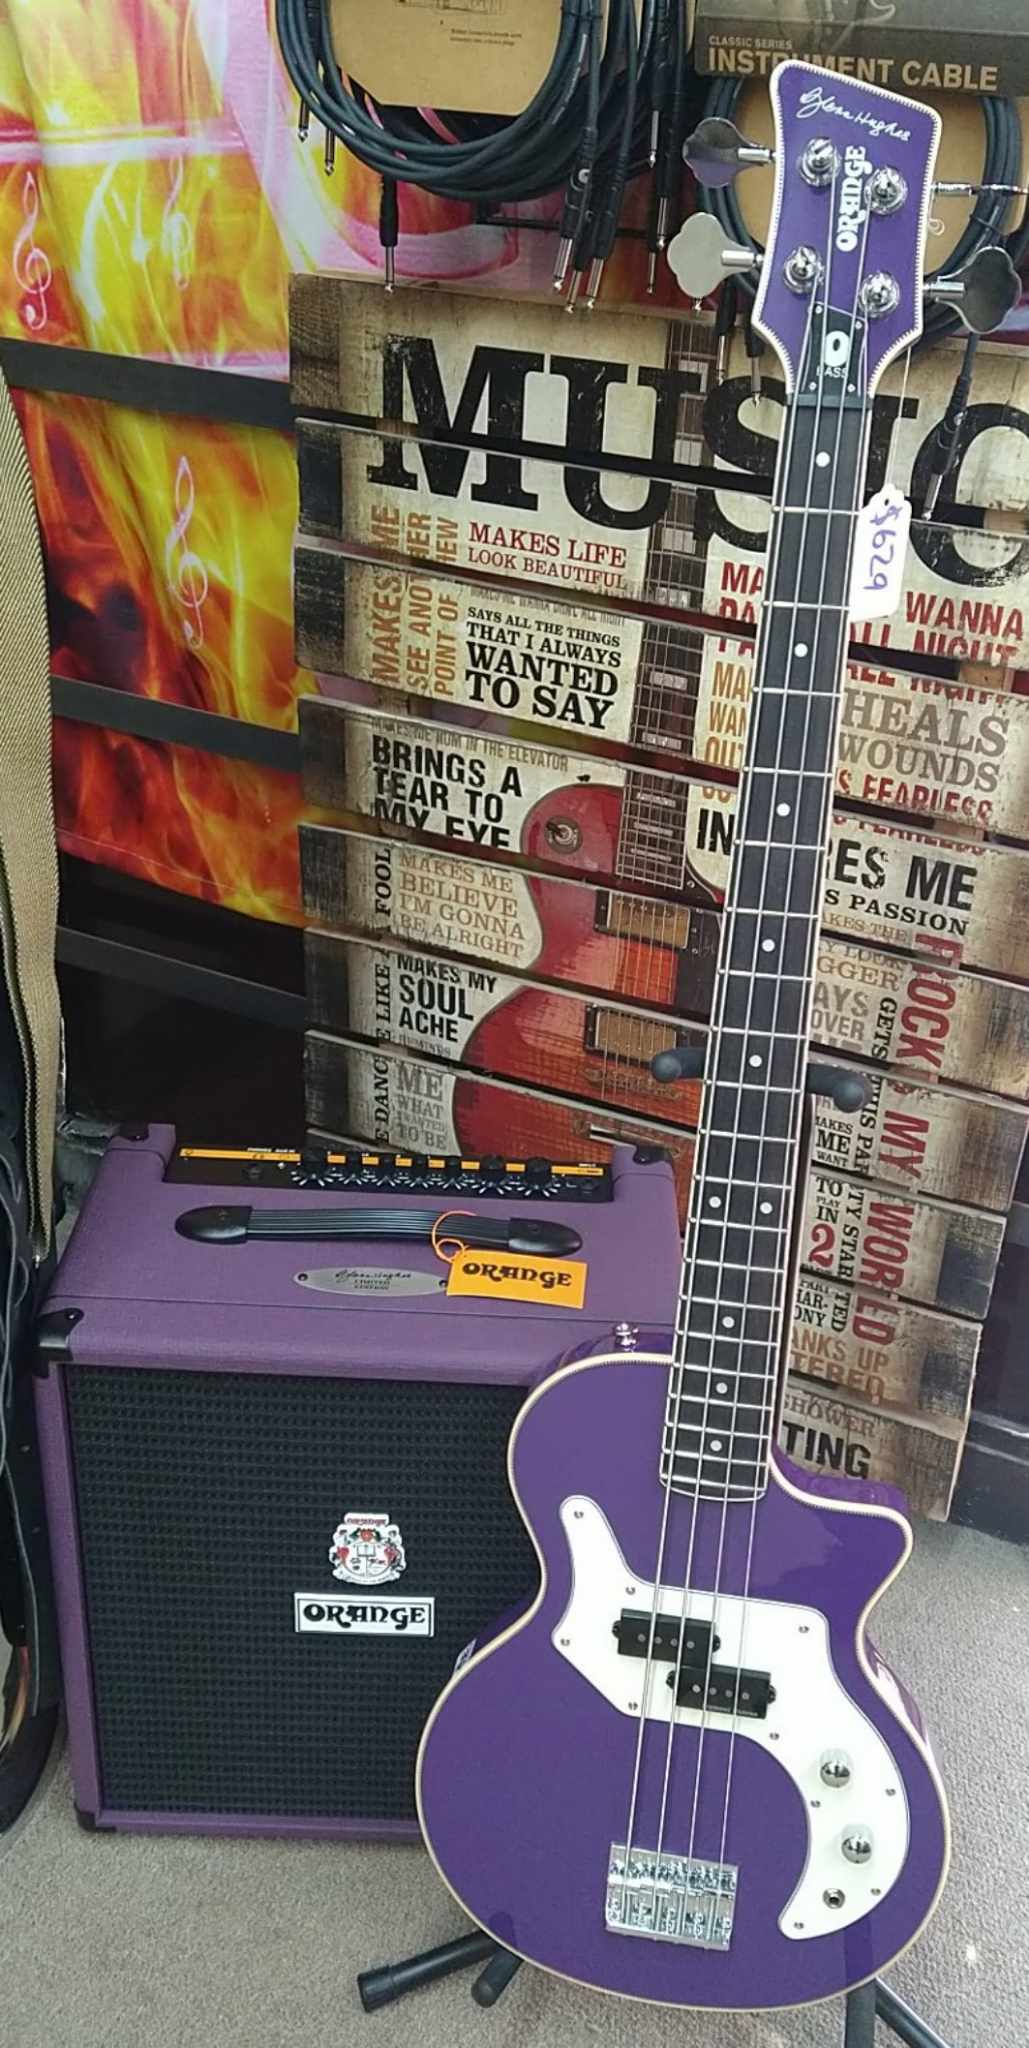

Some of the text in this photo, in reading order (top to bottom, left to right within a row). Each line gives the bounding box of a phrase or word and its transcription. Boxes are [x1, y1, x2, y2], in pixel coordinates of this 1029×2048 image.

[709, 35, 792, 50] CLASSIC SERIES
[901, 60, 999, 92] CABLE
[836, 145, 873, 252] ORANGE
[468, 547, 628, 590] LOOK BEAUTIFUL
[469, 521, 628, 569] MAKES LIFE
[863, 503, 903, 592] $629
[371, 574, 402, 685] MAKES
[434, 516, 459, 696] POINT OF IEW
[468, 606, 502, 624] SAYS
[505, 614, 532, 630] ALL
[535, 619, 564, 636] THE
[566, 627, 621, 647] THINGS
[906, 591, 1024, 641] WANNA
[406, 643, 430, 690] SEE
[466, 621, 622, 668] THAT I ALWAYS
[466, 641, 618, 697] WANTED
[712, 661, 753, 703] MA
[465, 669, 615, 730] TO SAY
[841, 687, 1011, 758] HEALS
[372, 734, 522, 798] BRINGS A
[482, 740, 506, 757] THE
[508, 745, 569, 772] ELEVATOR
[839, 731, 1001, 793] WOUNDS
[373, 766, 504, 824] TEAR TO
[373, 797, 510, 849] MY EYE
[374, 848, 392, 917] FOOL
[400, 851, 513, 894] MAKES ME
[400, 870, 518, 919] BELIEVE
[827, 838, 889, 890] ES
[905, 855, 978, 912] ME
[400, 892, 525, 941] I'M GONNA
[400, 913, 524, 959] BE ALRIGHT
[848, 893, 970, 937] PASSION
[870, 922, 908, 944] THE
[374, 963, 391, 1024] LIKE
[396, 953, 497, 994] MAKES MY
[399, 974, 474, 1021] SOUL
[399, 1006, 459, 1043] ACHE
[810, 1009, 865, 1041] OVER
[871, 996, 898, 1060] GETS
[399, 1122, 419, 1143] TO
[425, 1130, 448, 1151] BE
[816, 1129, 852, 1155] ME
[817, 1151, 849, 1168] WANT
[852, 933, 963, 1346] ROCK MY WORLD
[815, 1176, 843, 1198] TO
[816, 1205, 840, 1225] IN
[808, 1223, 836, 1269] 2
[461, 1262, 574, 1290] ORANGE
[858, 1346, 890, 1374] UP
[782, 1420, 872, 1480] TING
[303, 1603, 426, 1631] ORANGE
